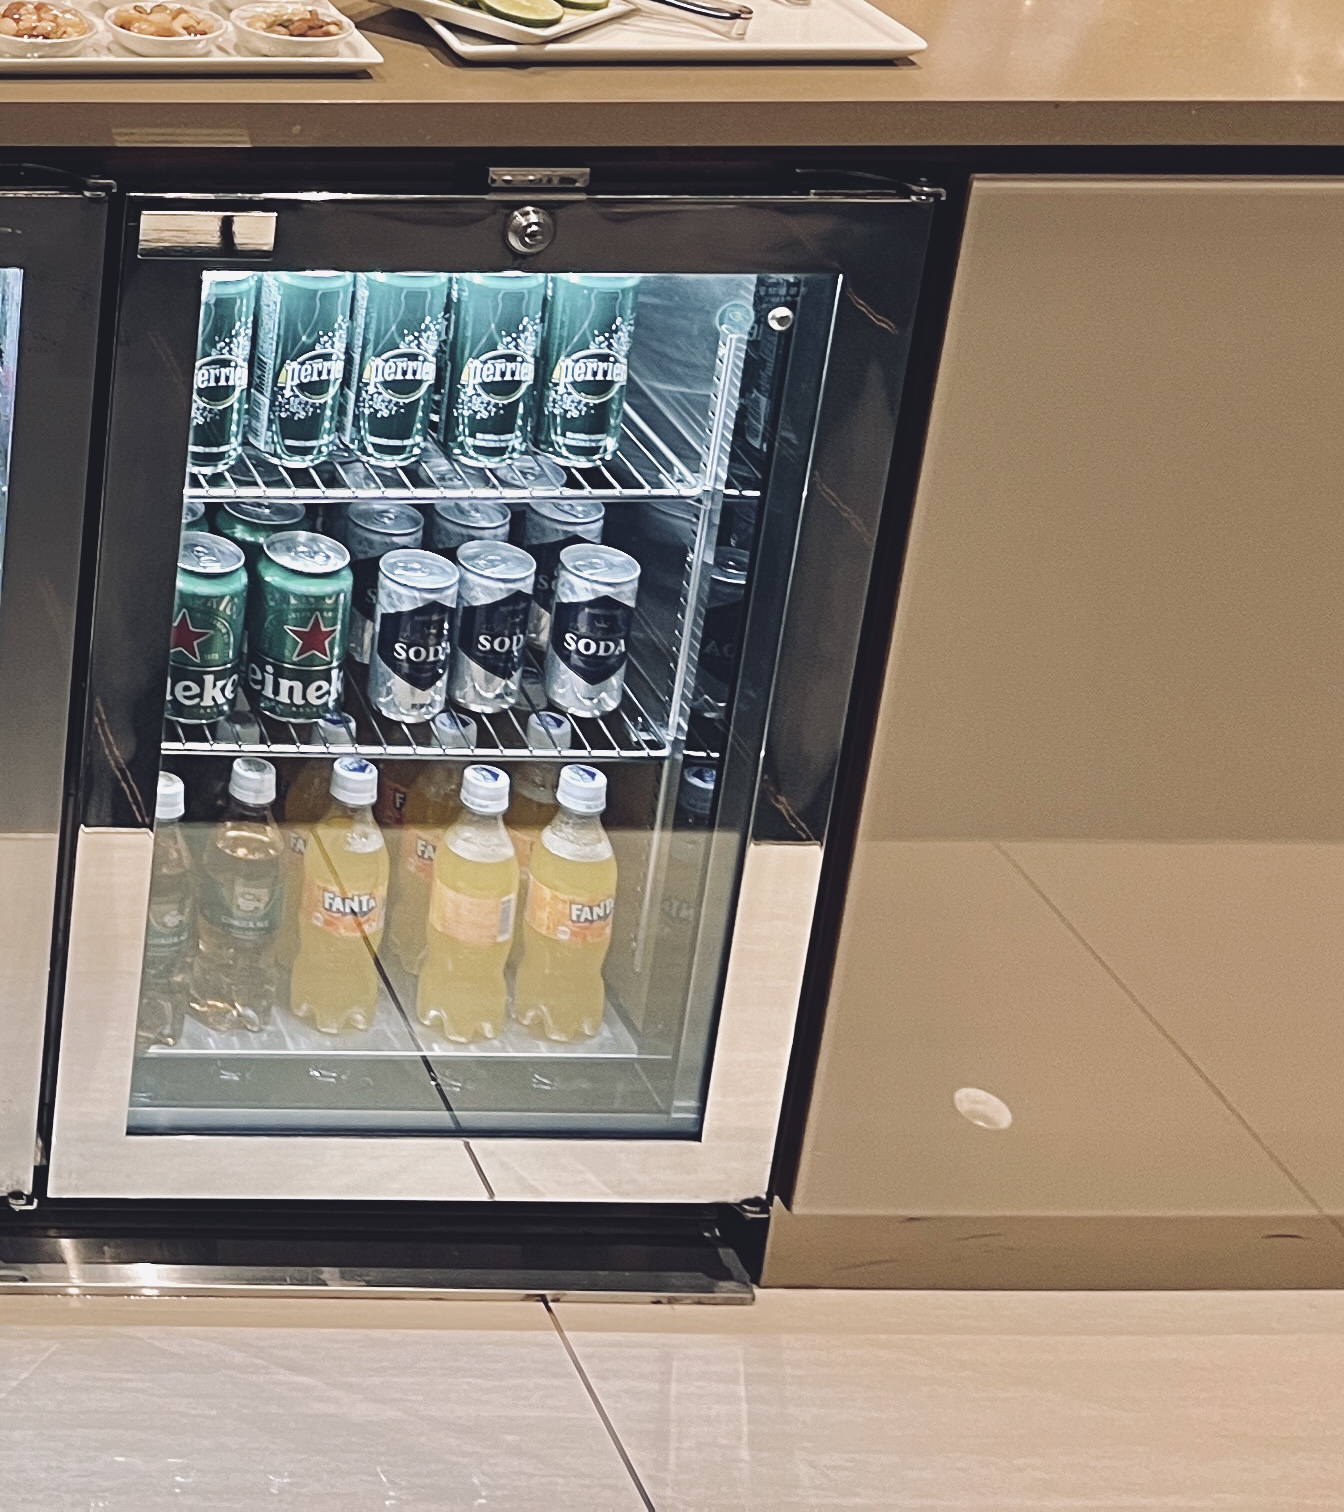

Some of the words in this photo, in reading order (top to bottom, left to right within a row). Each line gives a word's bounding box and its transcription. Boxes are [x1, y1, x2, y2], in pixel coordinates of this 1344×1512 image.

[477, 633, 524, 653] SOD
[563, 632, 627, 657] SODA
[323, 891, 377, 914] FANTA
[570, 897, 614, 924] FANT
